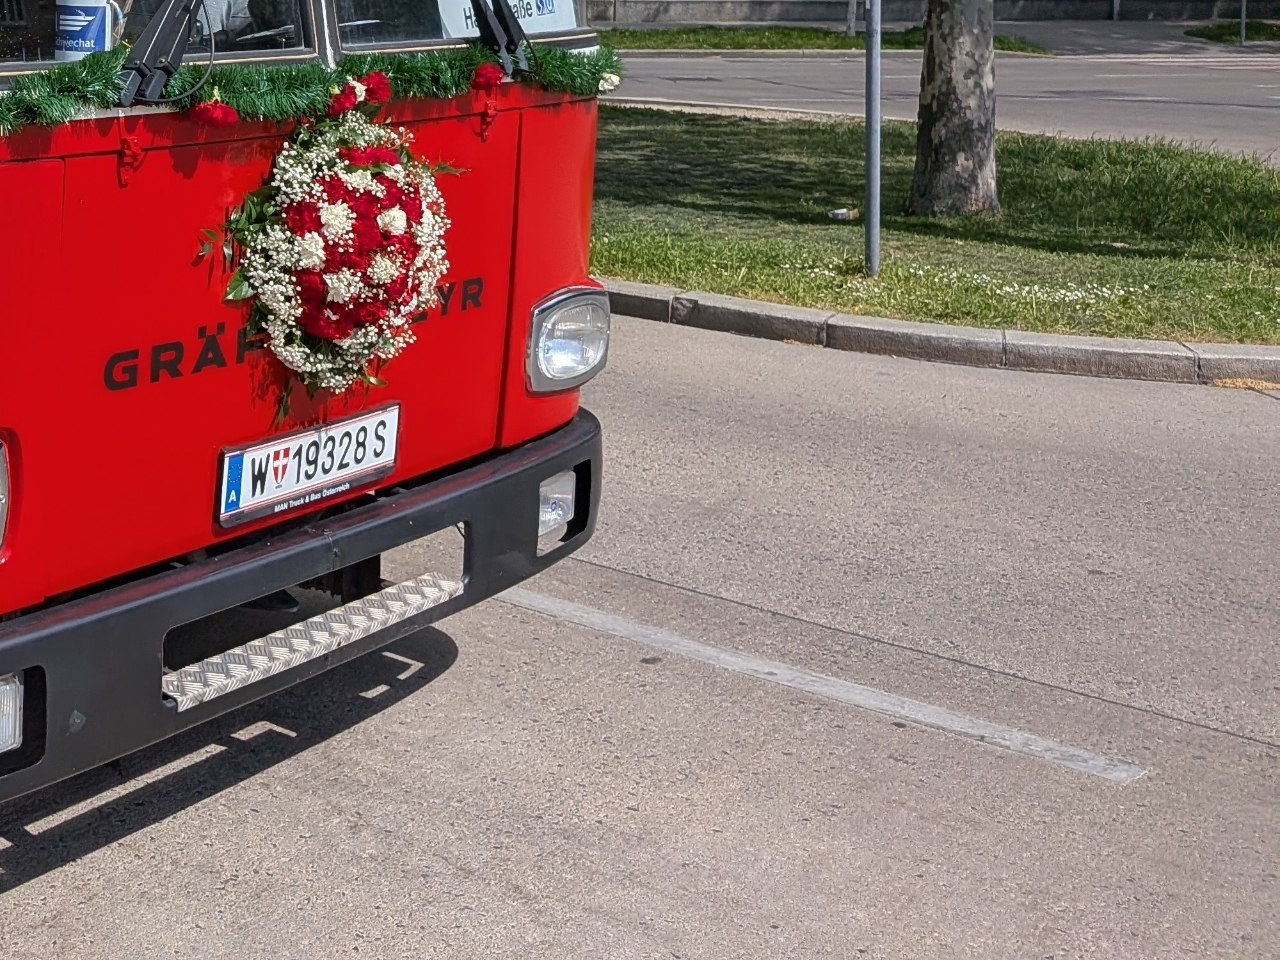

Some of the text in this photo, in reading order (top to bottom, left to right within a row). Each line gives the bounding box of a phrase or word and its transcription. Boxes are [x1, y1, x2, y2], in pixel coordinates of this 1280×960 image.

[228, 490, 237, 503] A
[250, 452, 270, 498] W
[274, 501, 288, 512] MAN
[289, 497, 305, 508] Truck
[304, 495, 310, 503] &
[310, 492, 321, 501] Bus
